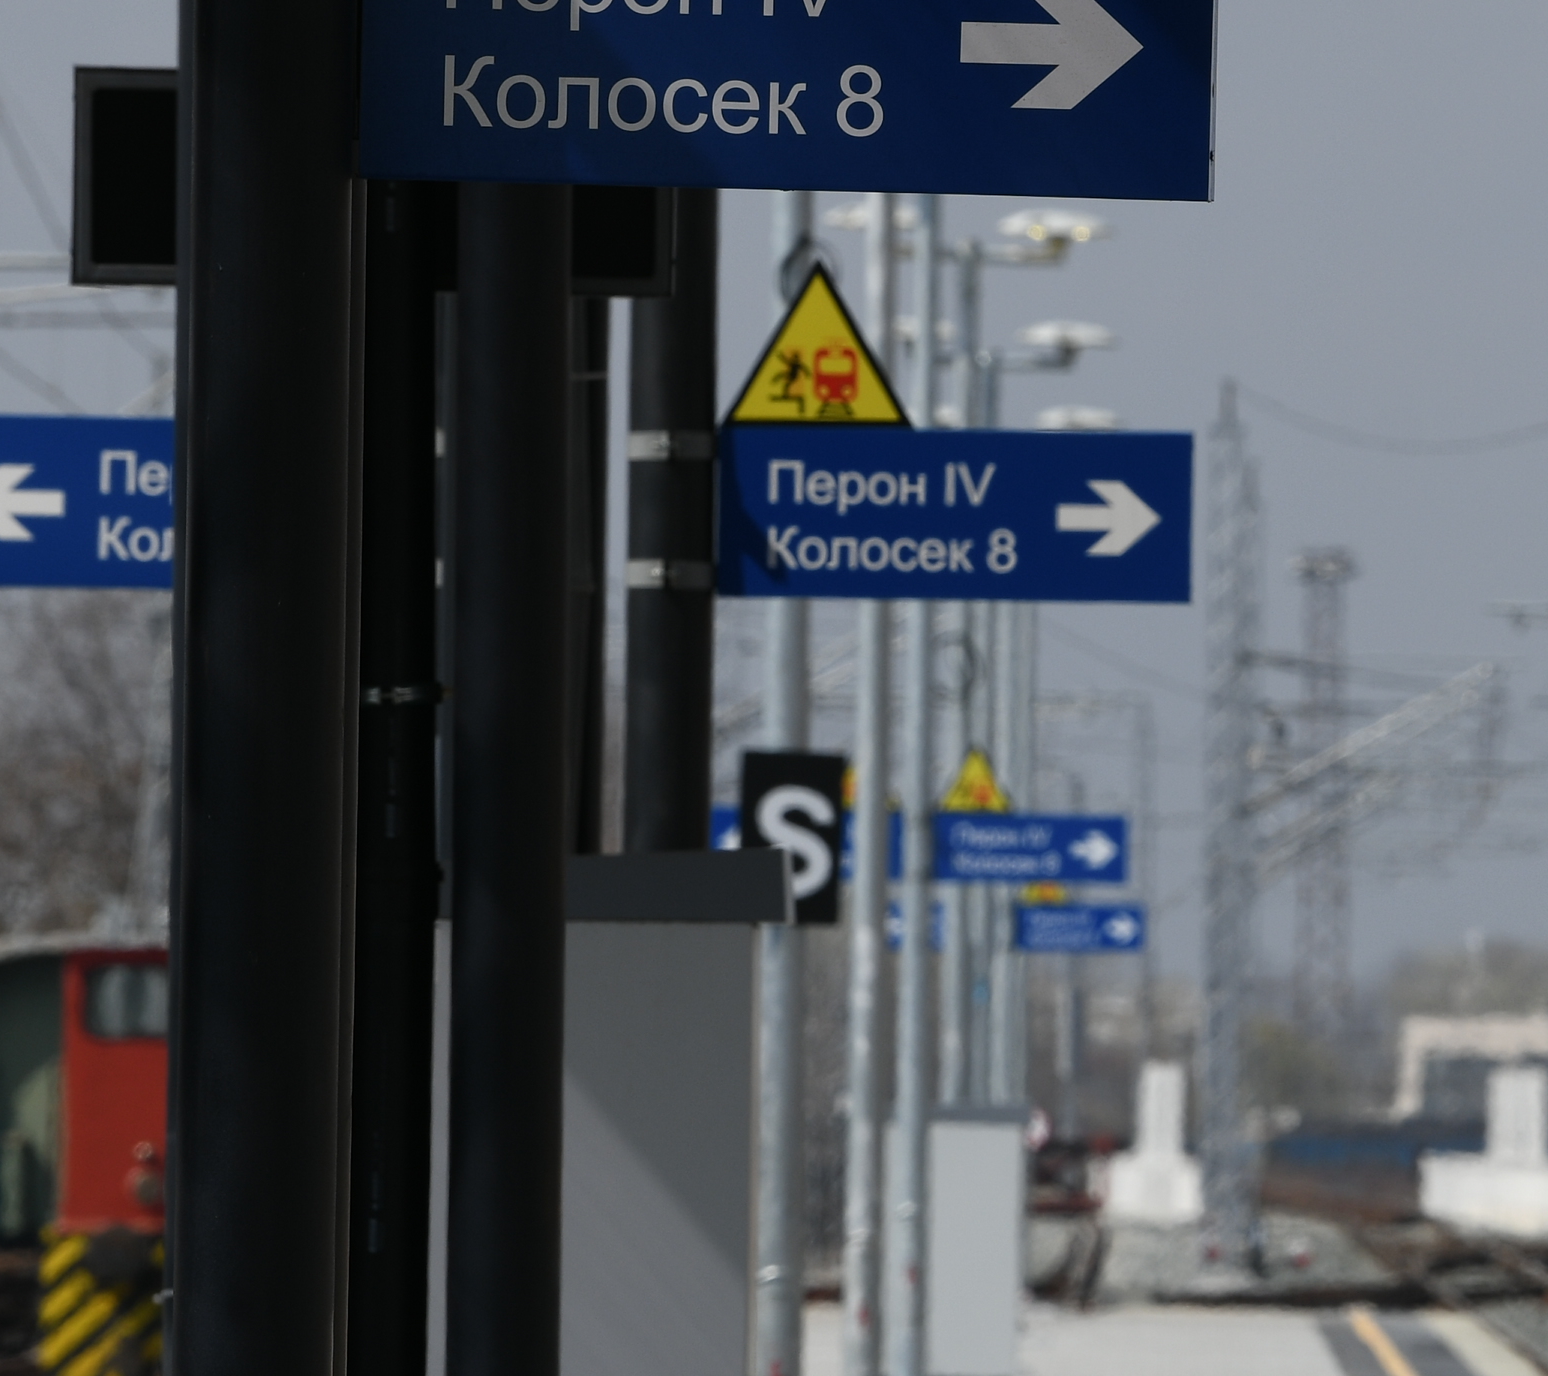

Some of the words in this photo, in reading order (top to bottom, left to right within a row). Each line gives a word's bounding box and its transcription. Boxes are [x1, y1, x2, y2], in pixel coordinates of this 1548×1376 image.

[442, 54, 809, 137] Колосек
[836, 64, 886, 140] 8
[767, 459, 929, 517] Перон
[944, 462, 998, 508] IV
[767, 525, 976, 574] Колосек
[986, 528, 1020, 576] 8
[755, 784, 836, 900] S
